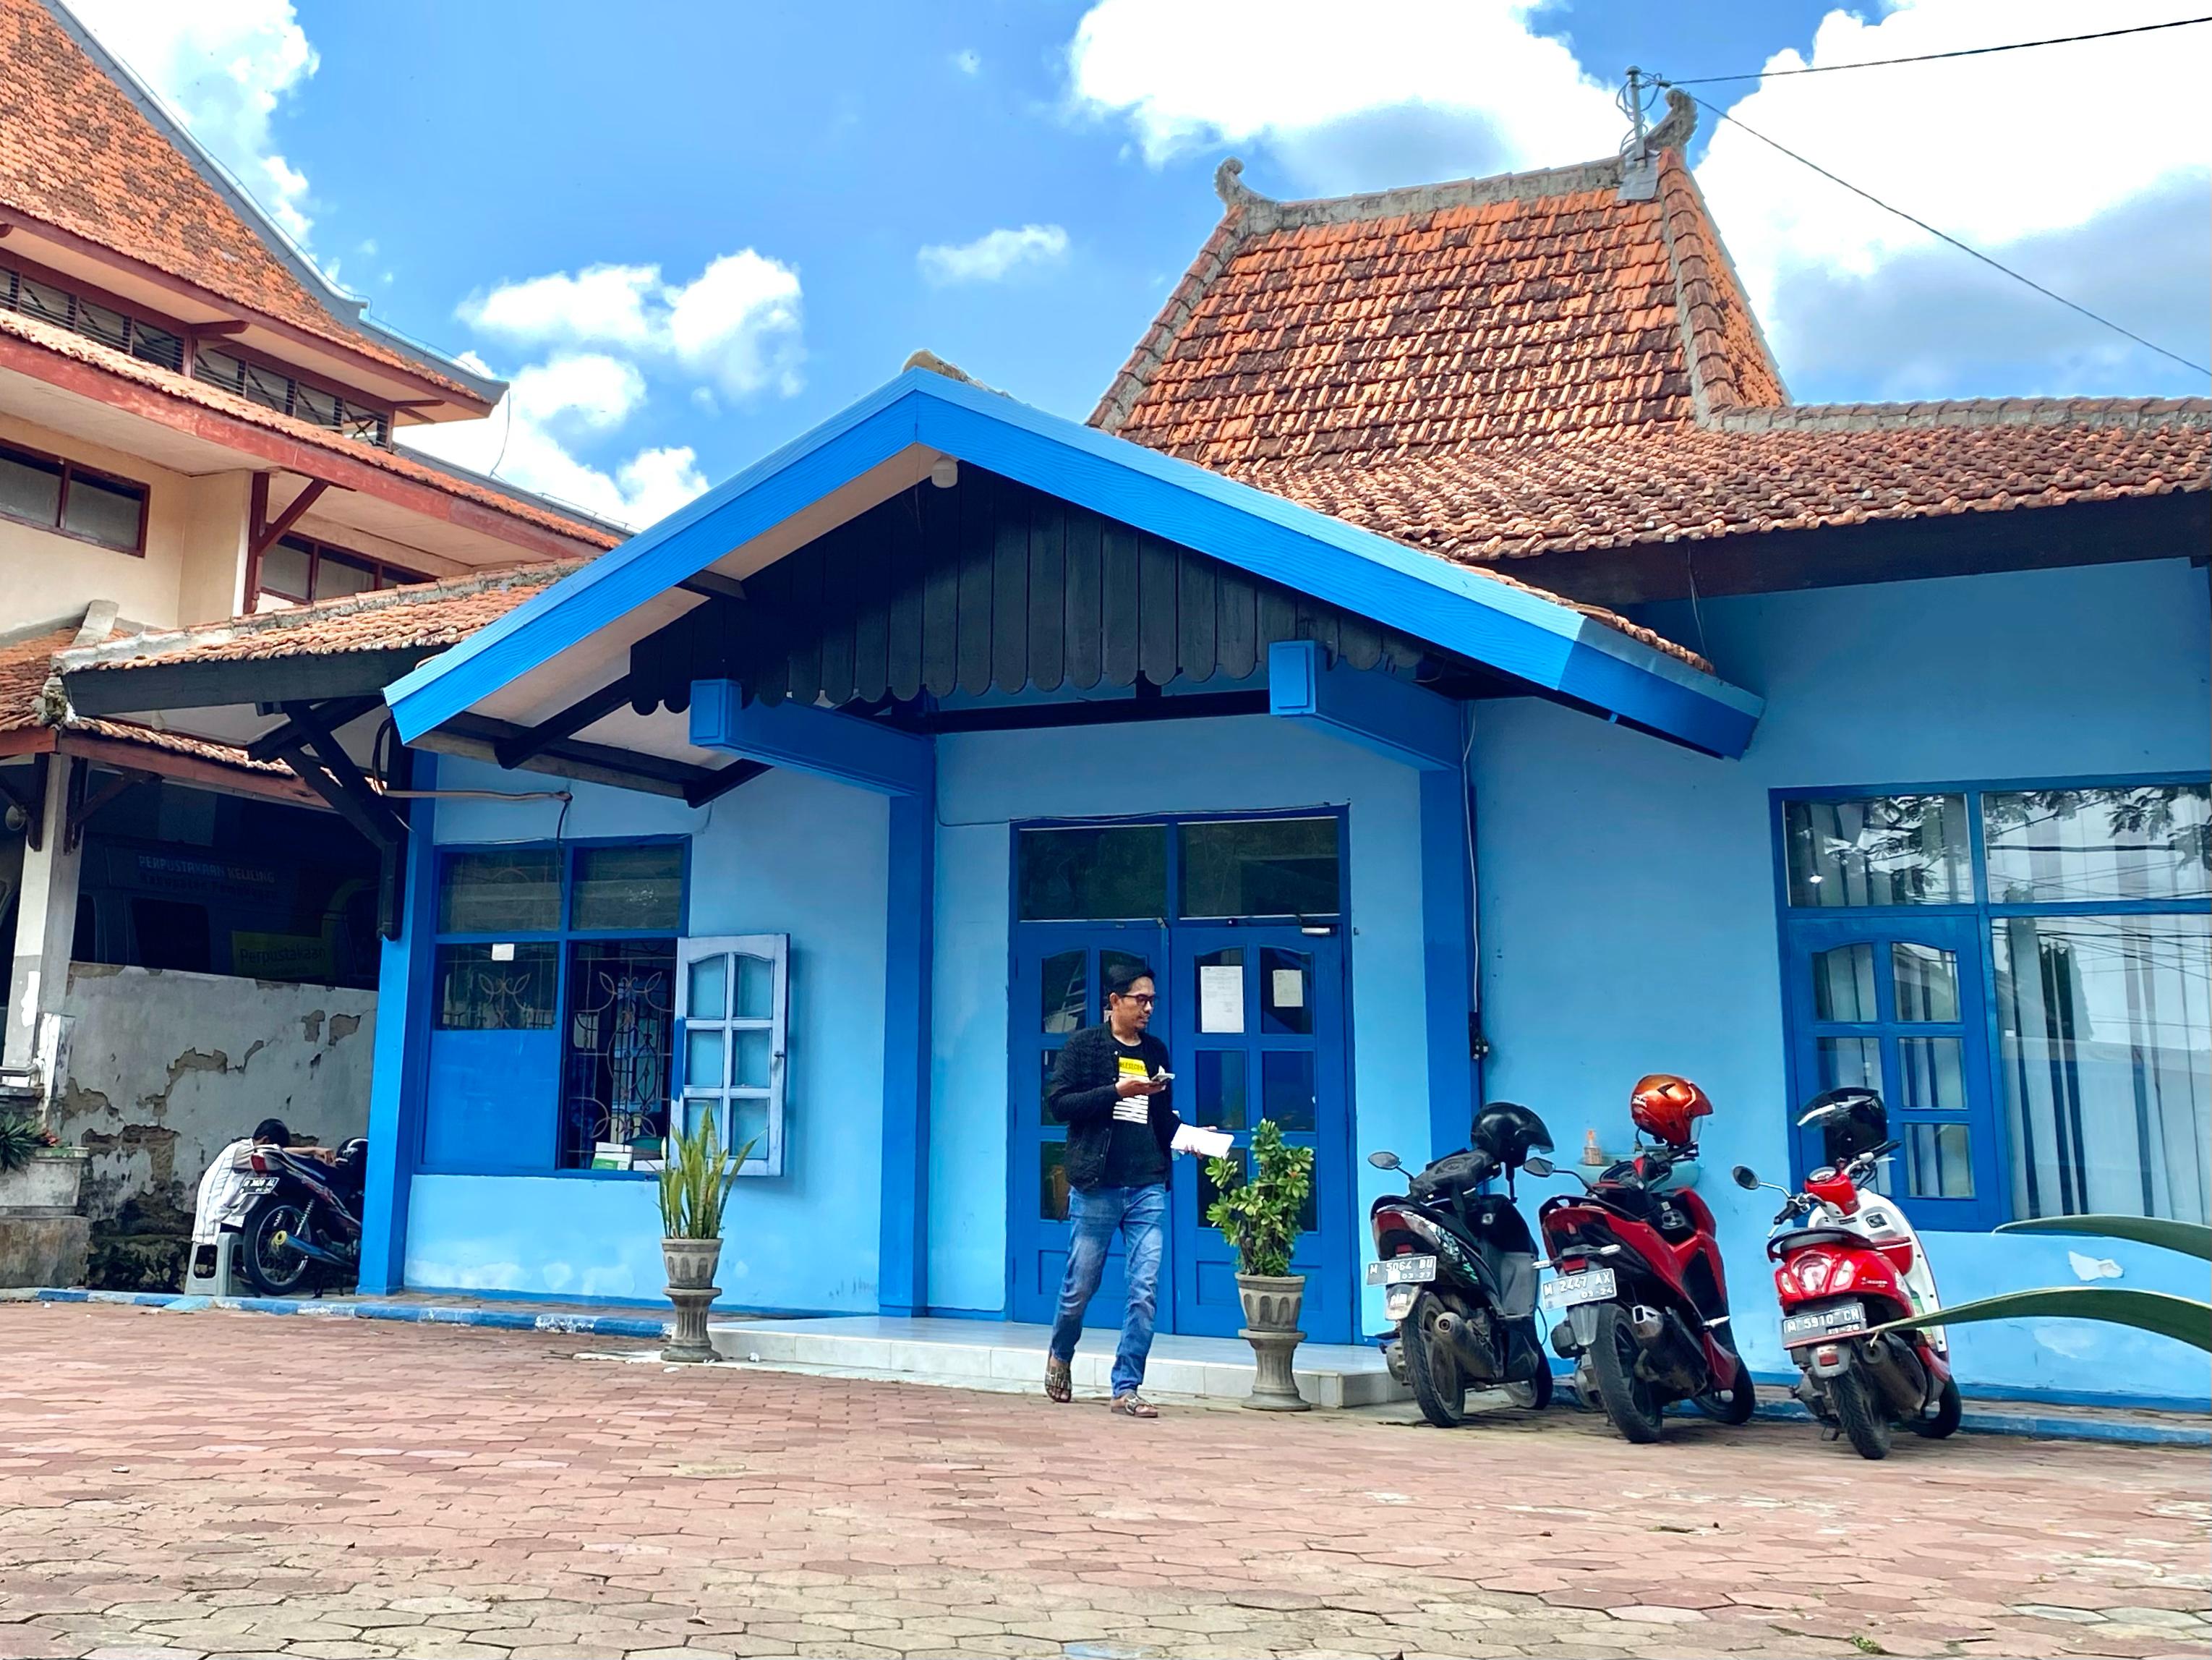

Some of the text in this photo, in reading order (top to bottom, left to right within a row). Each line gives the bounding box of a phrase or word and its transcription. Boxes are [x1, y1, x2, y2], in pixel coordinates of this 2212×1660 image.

[138, 855, 276, 884] PERPUSTAKAAN KELILING
[239, 943, 325, 966] Perpustakaan
[1386, 1261, 1412, 1272] 5064
[1419, 1258, 1434, 1269] BU
[1544, 1272, 1610, 1295] M 2447 AX
[1803, 1314, 1834, 1329] 5910
